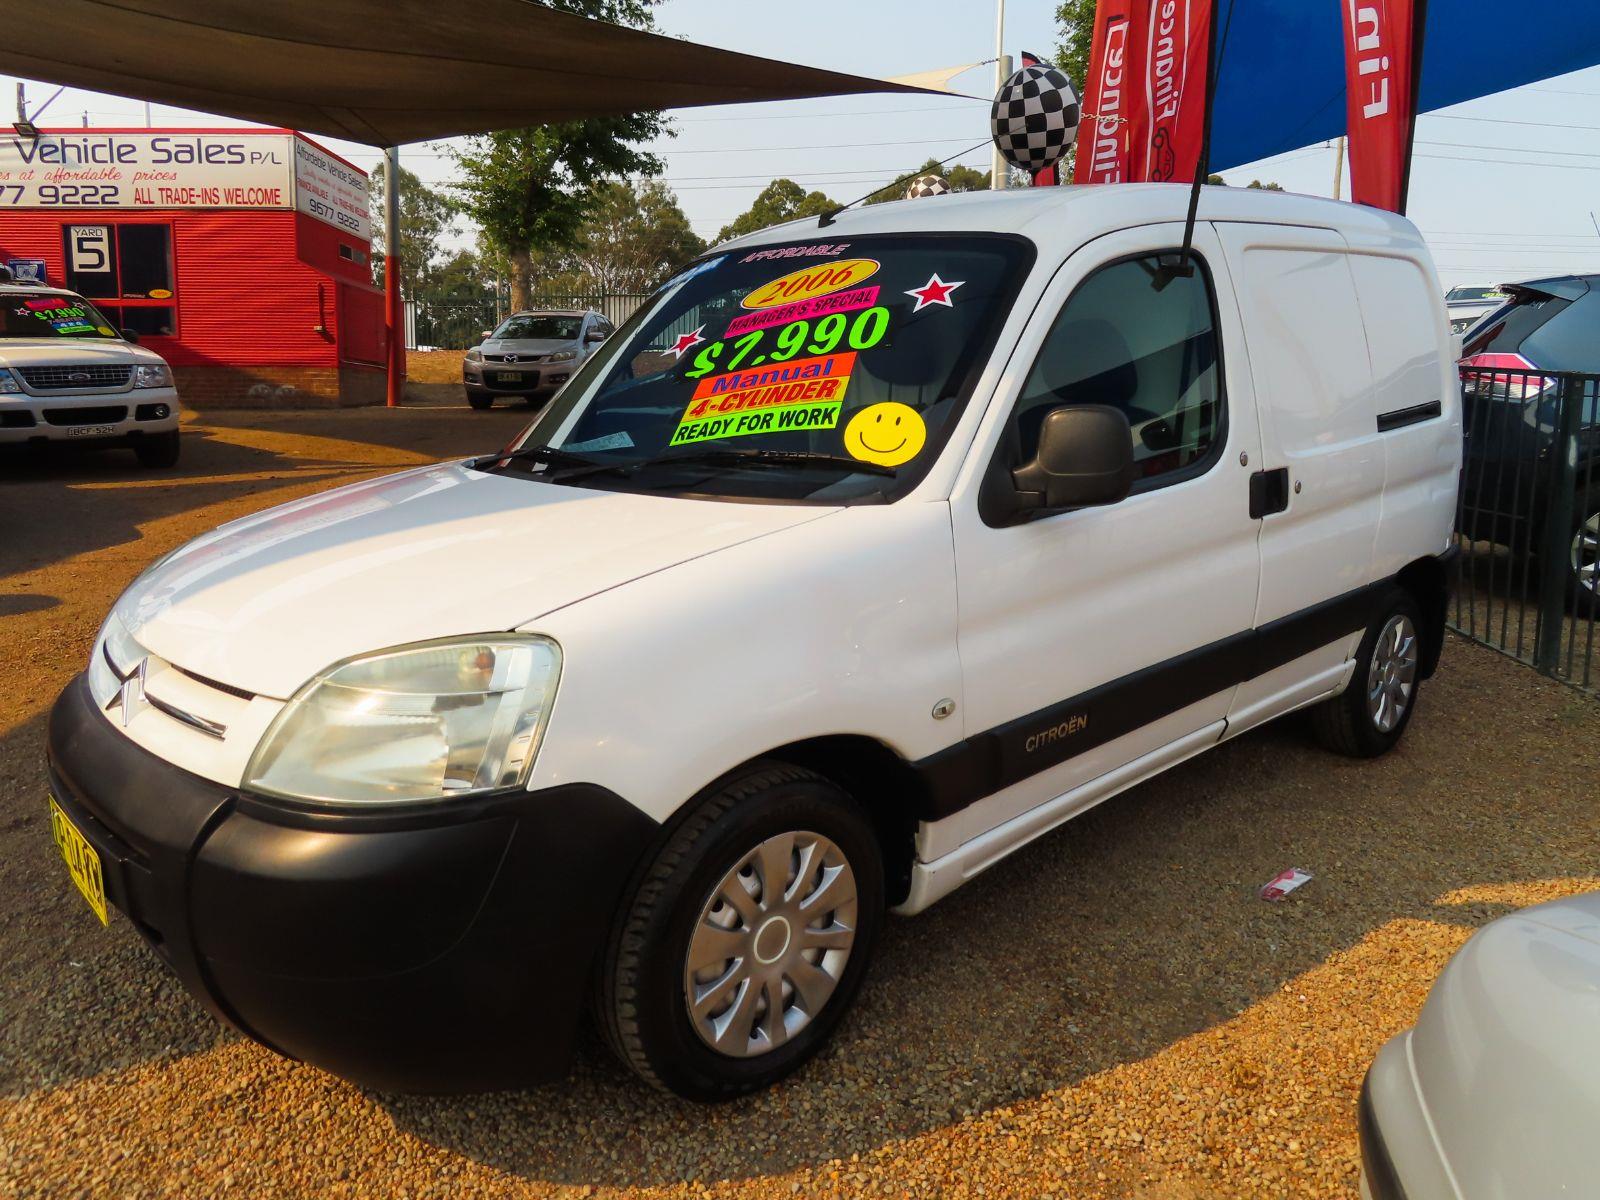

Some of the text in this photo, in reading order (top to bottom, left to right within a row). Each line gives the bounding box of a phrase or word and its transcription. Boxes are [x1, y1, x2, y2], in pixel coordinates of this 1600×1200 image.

[14, 137, 282, 165] Vehicle Sales P/L
[19, 169, 35, 180] at
[44, 167, 121, 183] affordable
[132, 169, 178, 184] prices
[38, 185, 120, 205] 9222
[134, 187, 155, 205] ALL
[158, 187, 221, 206] TRADE-INS
[223, 187, 282, 206] WELCOME
[309, 198, 335, 220] 9677
[337, 211, 361, 232] 9222
[73, 228, 104, 237] YARD
[76, 236, 105, 270] 5
[738, 244, 851, 264] AFFORDABLE
[757, 261, 862, 305] 2006
[727, 289, 874, 334] MANAGER'S SPECIAL
[711, 358, 835, 395] Manual
[689, 378, 842, 420] 4-CYLINDER
[674, 406, 838, 443] READY FOR WORK
[1025, 714, 1088, 753] CITROËN
